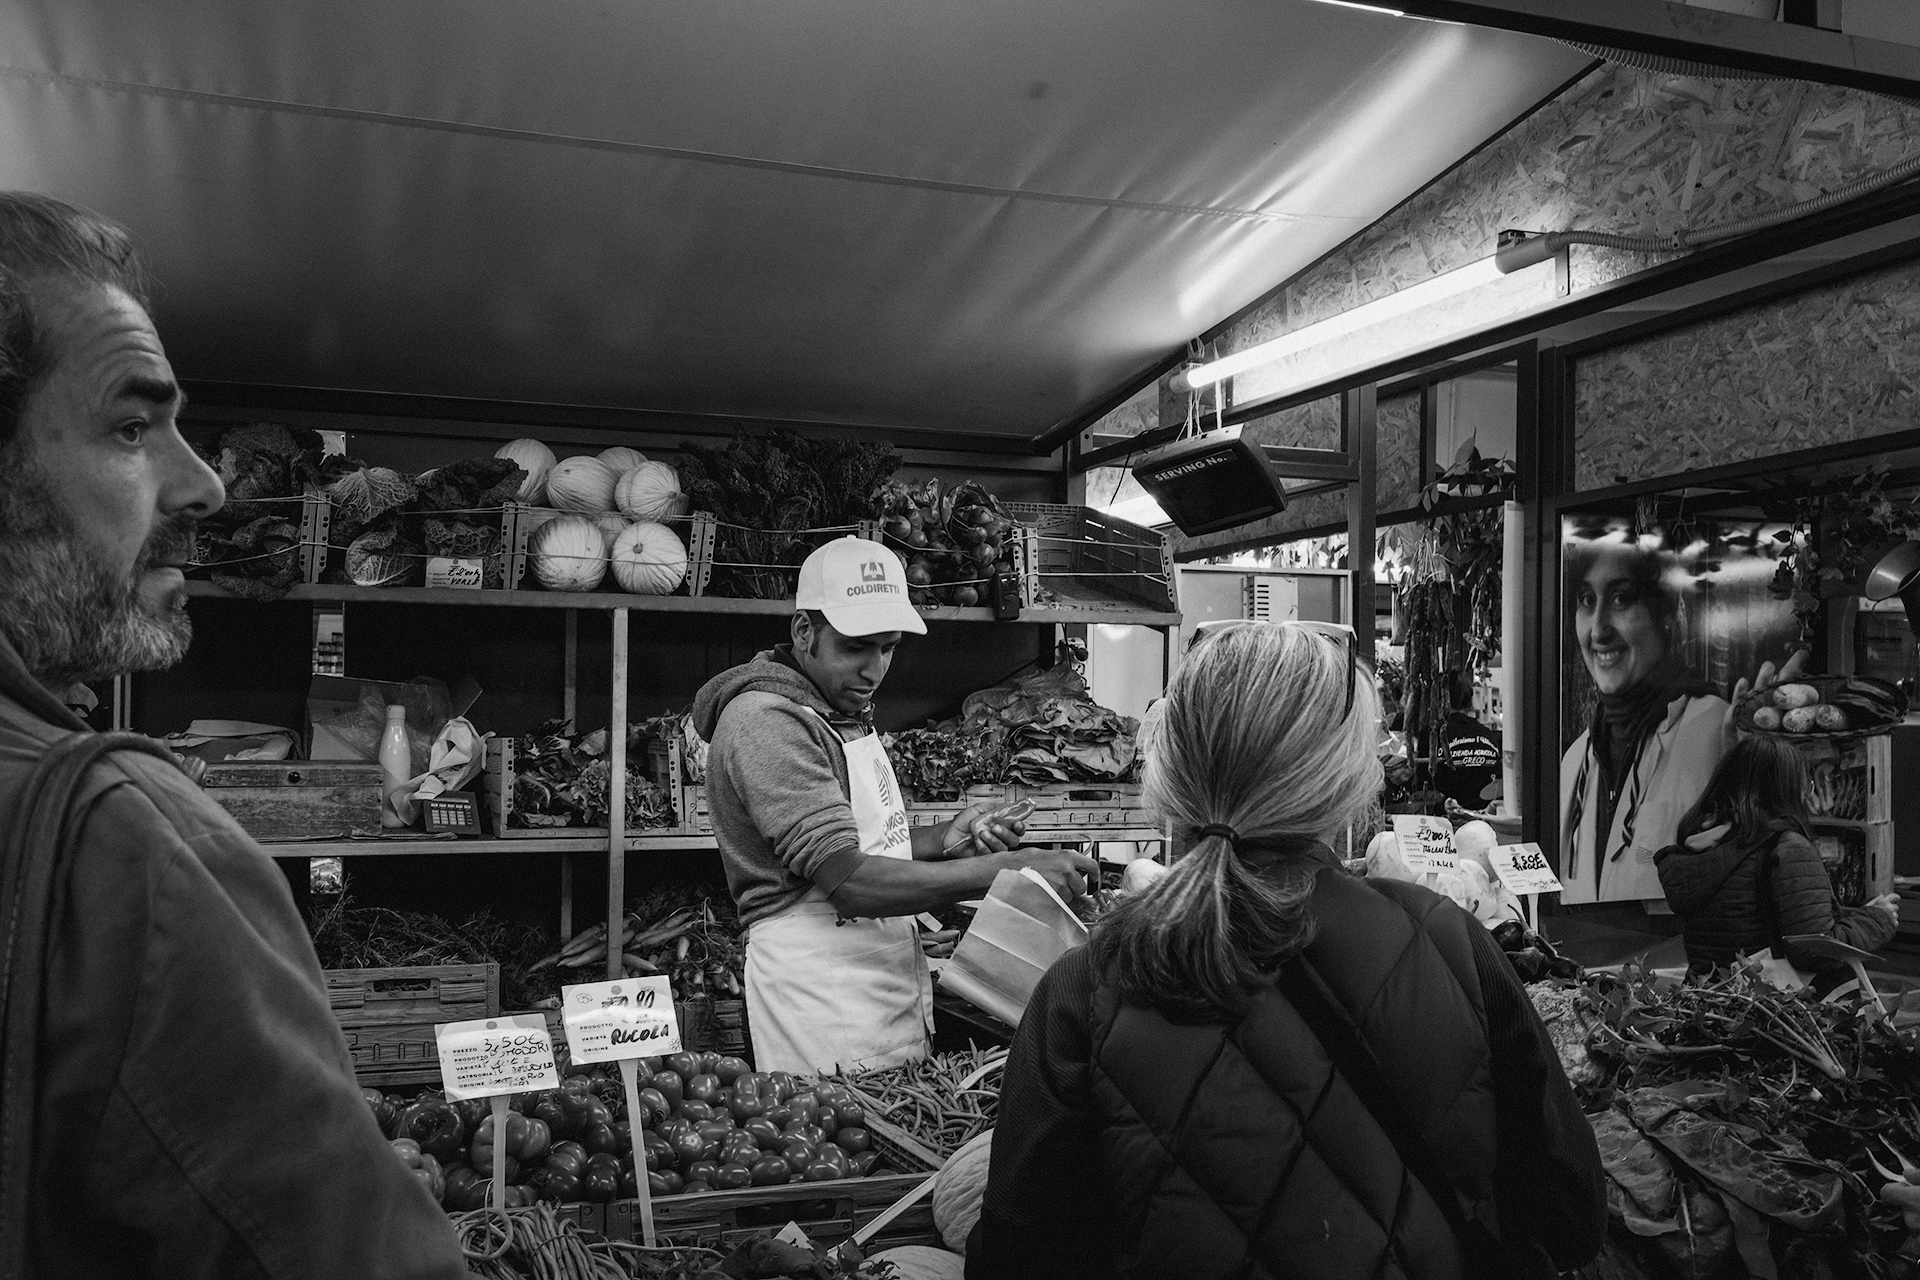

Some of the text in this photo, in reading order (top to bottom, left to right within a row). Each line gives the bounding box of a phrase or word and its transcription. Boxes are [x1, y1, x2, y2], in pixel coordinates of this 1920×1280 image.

[1155, 456, 1228, 482] SERVING No.
[846, 583, 900, 597] COLDIRETTI
[1462, 756, 1486, 765] GRECO
[579, 1022, 614, 1030] PRODOTTO
[581, 1024, 669, 1046] VARIETÀ RUCOLA
[454, 1055, 489, 1063] PRODOTTO
[457, 1072, 494, 1080] CATEGORIA
[458, 1081, 486, 1089] ORIGINE
